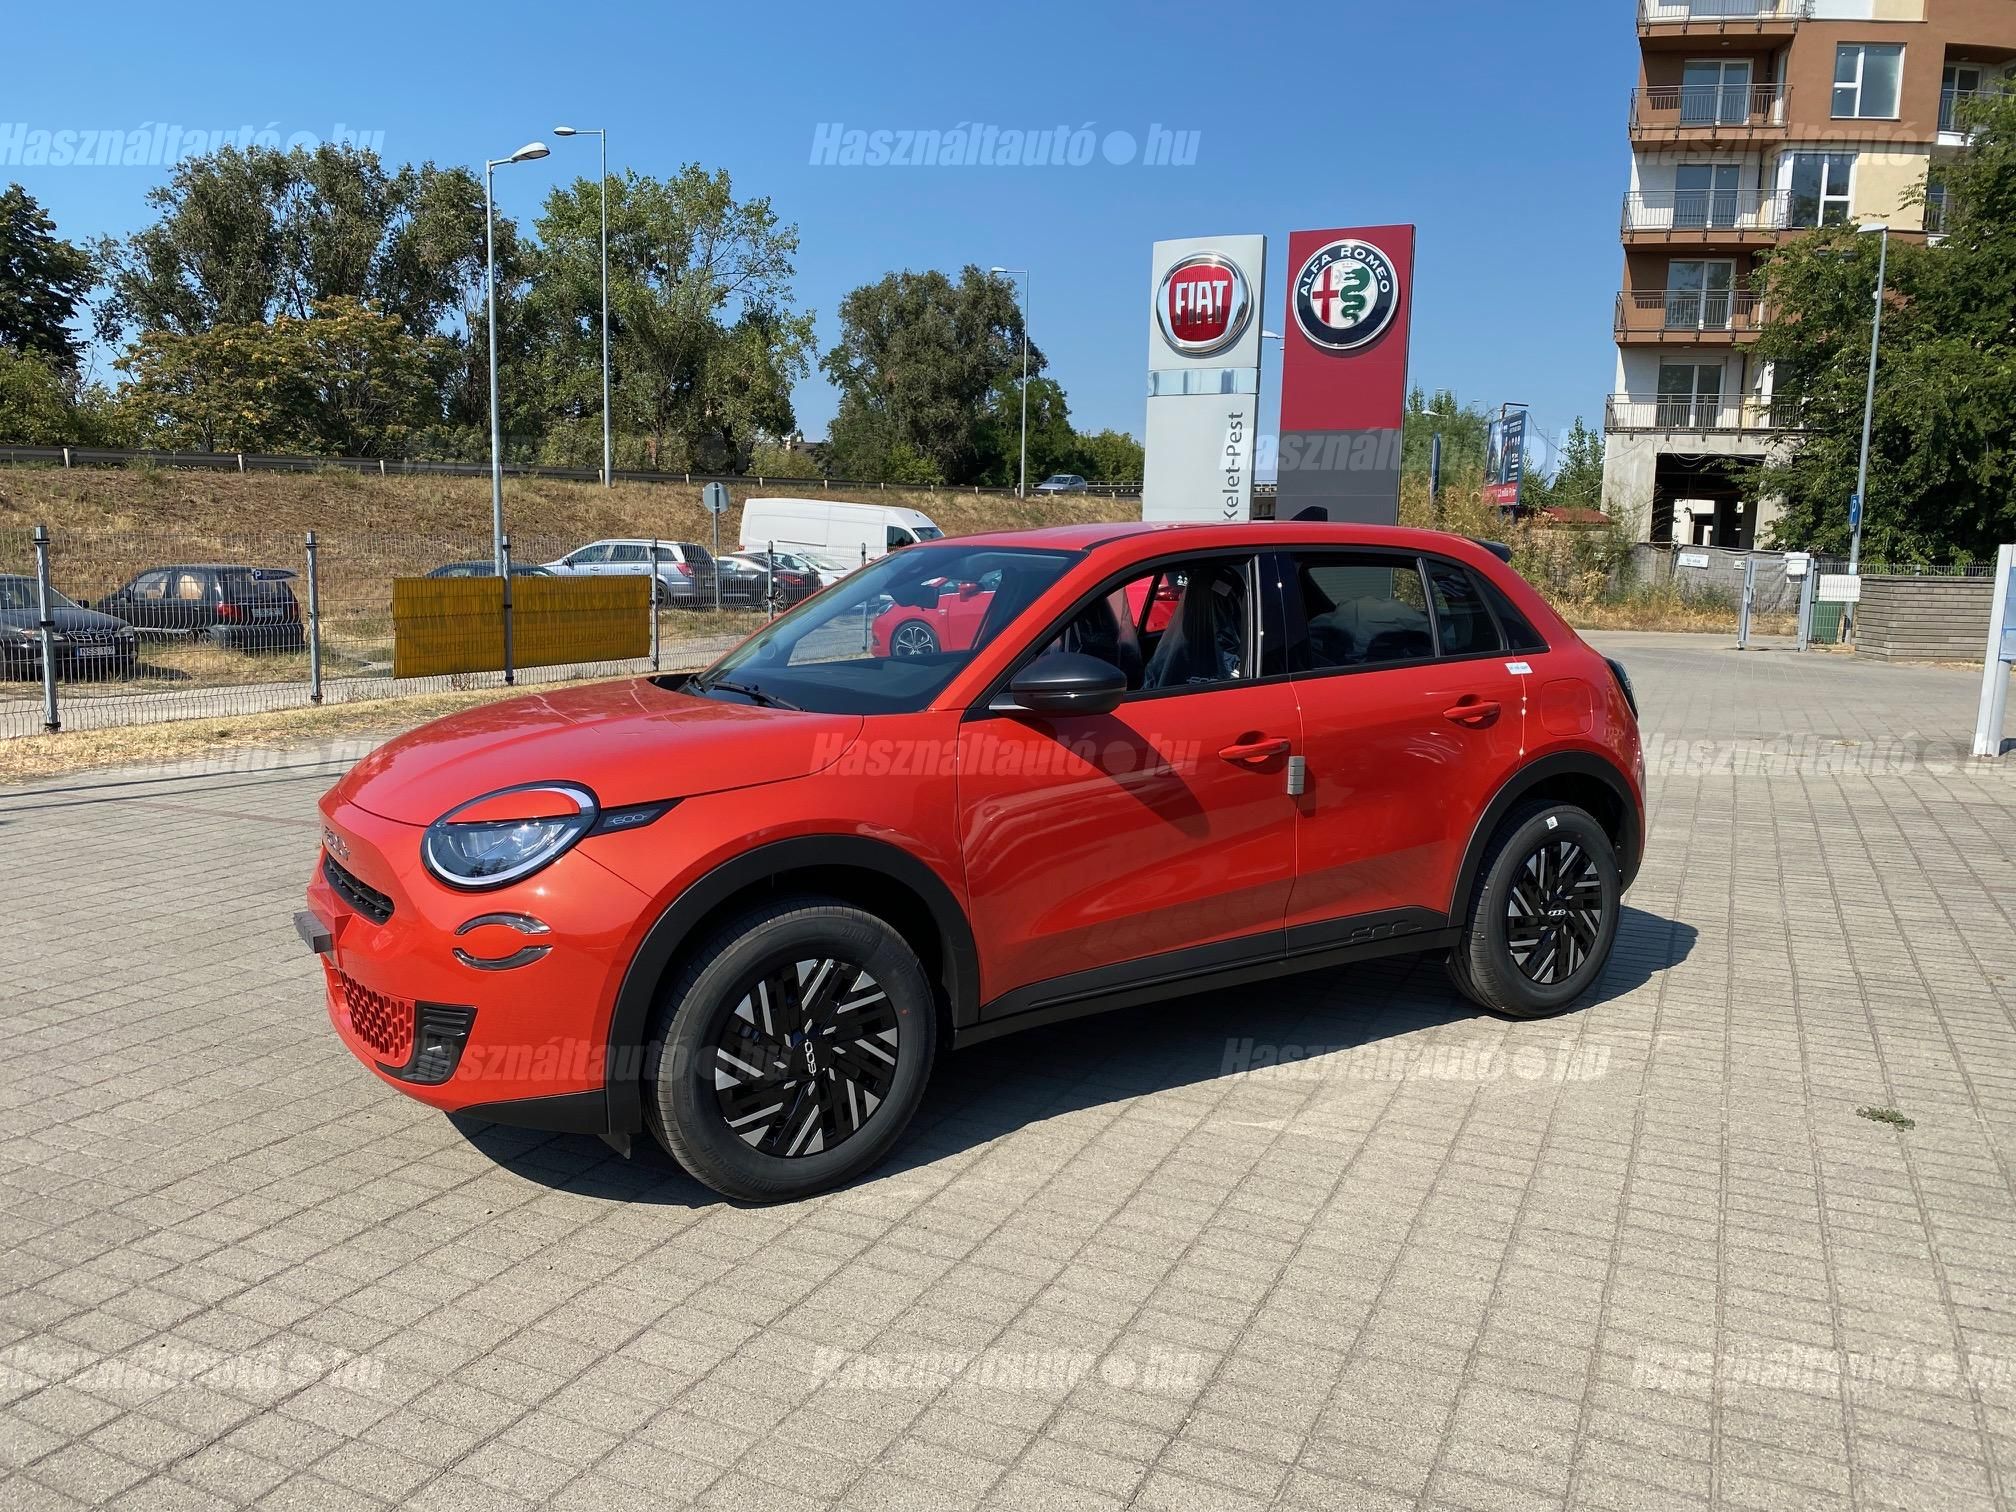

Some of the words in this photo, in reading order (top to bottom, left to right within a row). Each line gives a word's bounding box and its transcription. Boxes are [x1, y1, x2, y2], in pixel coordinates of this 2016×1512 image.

[1300, 254, 1333, 296] ALFA
[1340, 247, 1390, 293] ROMEO
[1175, 280, 1229, 325] FIAT
[1222, 412, 1243, 520] Kelet-Pest
